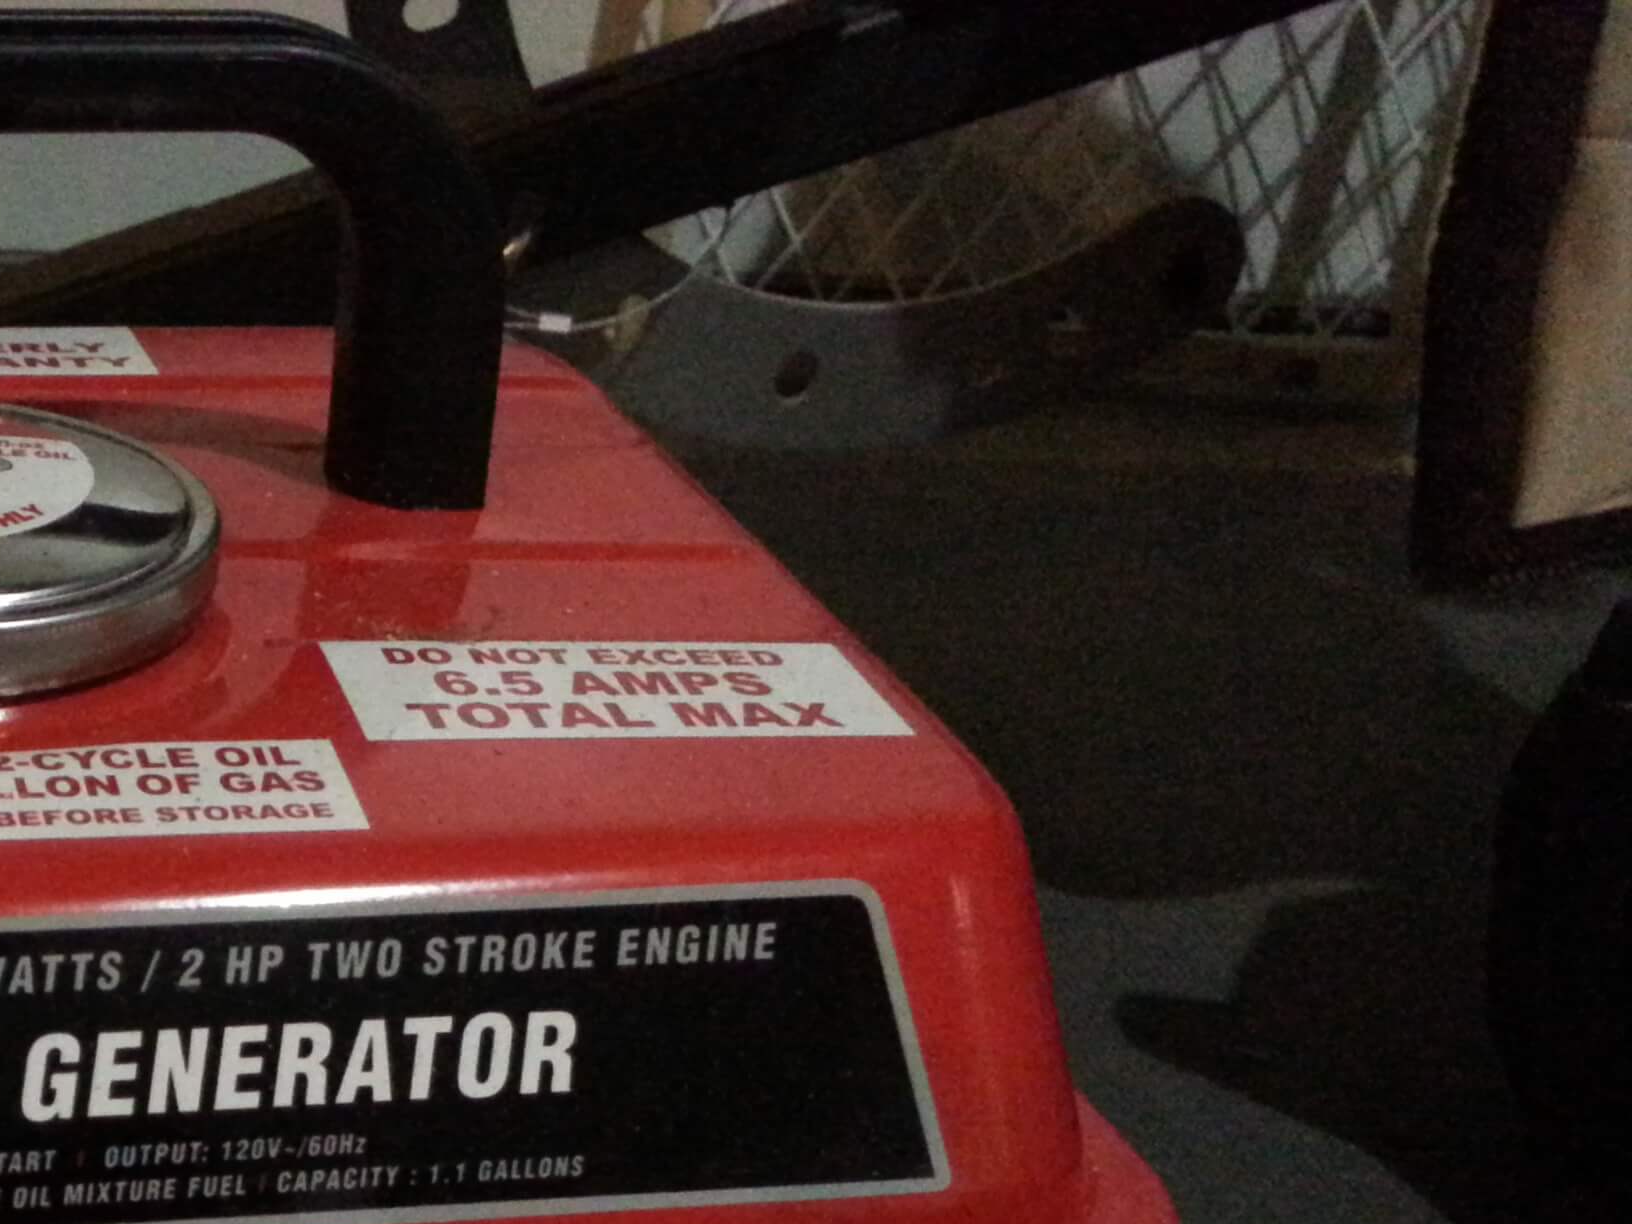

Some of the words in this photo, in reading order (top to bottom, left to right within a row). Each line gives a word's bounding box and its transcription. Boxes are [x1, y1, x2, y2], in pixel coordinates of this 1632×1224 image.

[32, 450, 75, 461] OIL
[382, 647, 453, 666] DO
[470, 647, 569, 666] NOT
[587, 648, 785, 668] EXCEED
[432, 670, 544, 697] 6.5
[568, 670, 772, 697] AMPS
[406, 702, 655, 730] TOTAL
[674, 702, 846, 728] MAX
[215, 746, 301, 767] OIL
[136, 773, 200, 795] OF
[219, 770, 326, 793] GAS
[155, 803, 335, 823] STORAGE
[178, 948, 206, 988] 2
[225, 945, 285, 986] HP
[308, 938, 402, 982] TWO
[421, 930, 598, 977] STROKE
[615, 921, 779, 968] ENGINE
[21, 1010, 579, 1123] GENERATOR
[104, 1139, 211, 1170] OUTPUT:
[12, 1182, 54, 1209] OIL
[62, 1175, 177, 1206] MIXTURE
[187, 1173, 248, 1198] FUEL
[276, 1165, 400, 1194] CAPACITY
[429, 1162, 467, 1185] 1.1
[477, 1154, 585, 1184] GALLONS
